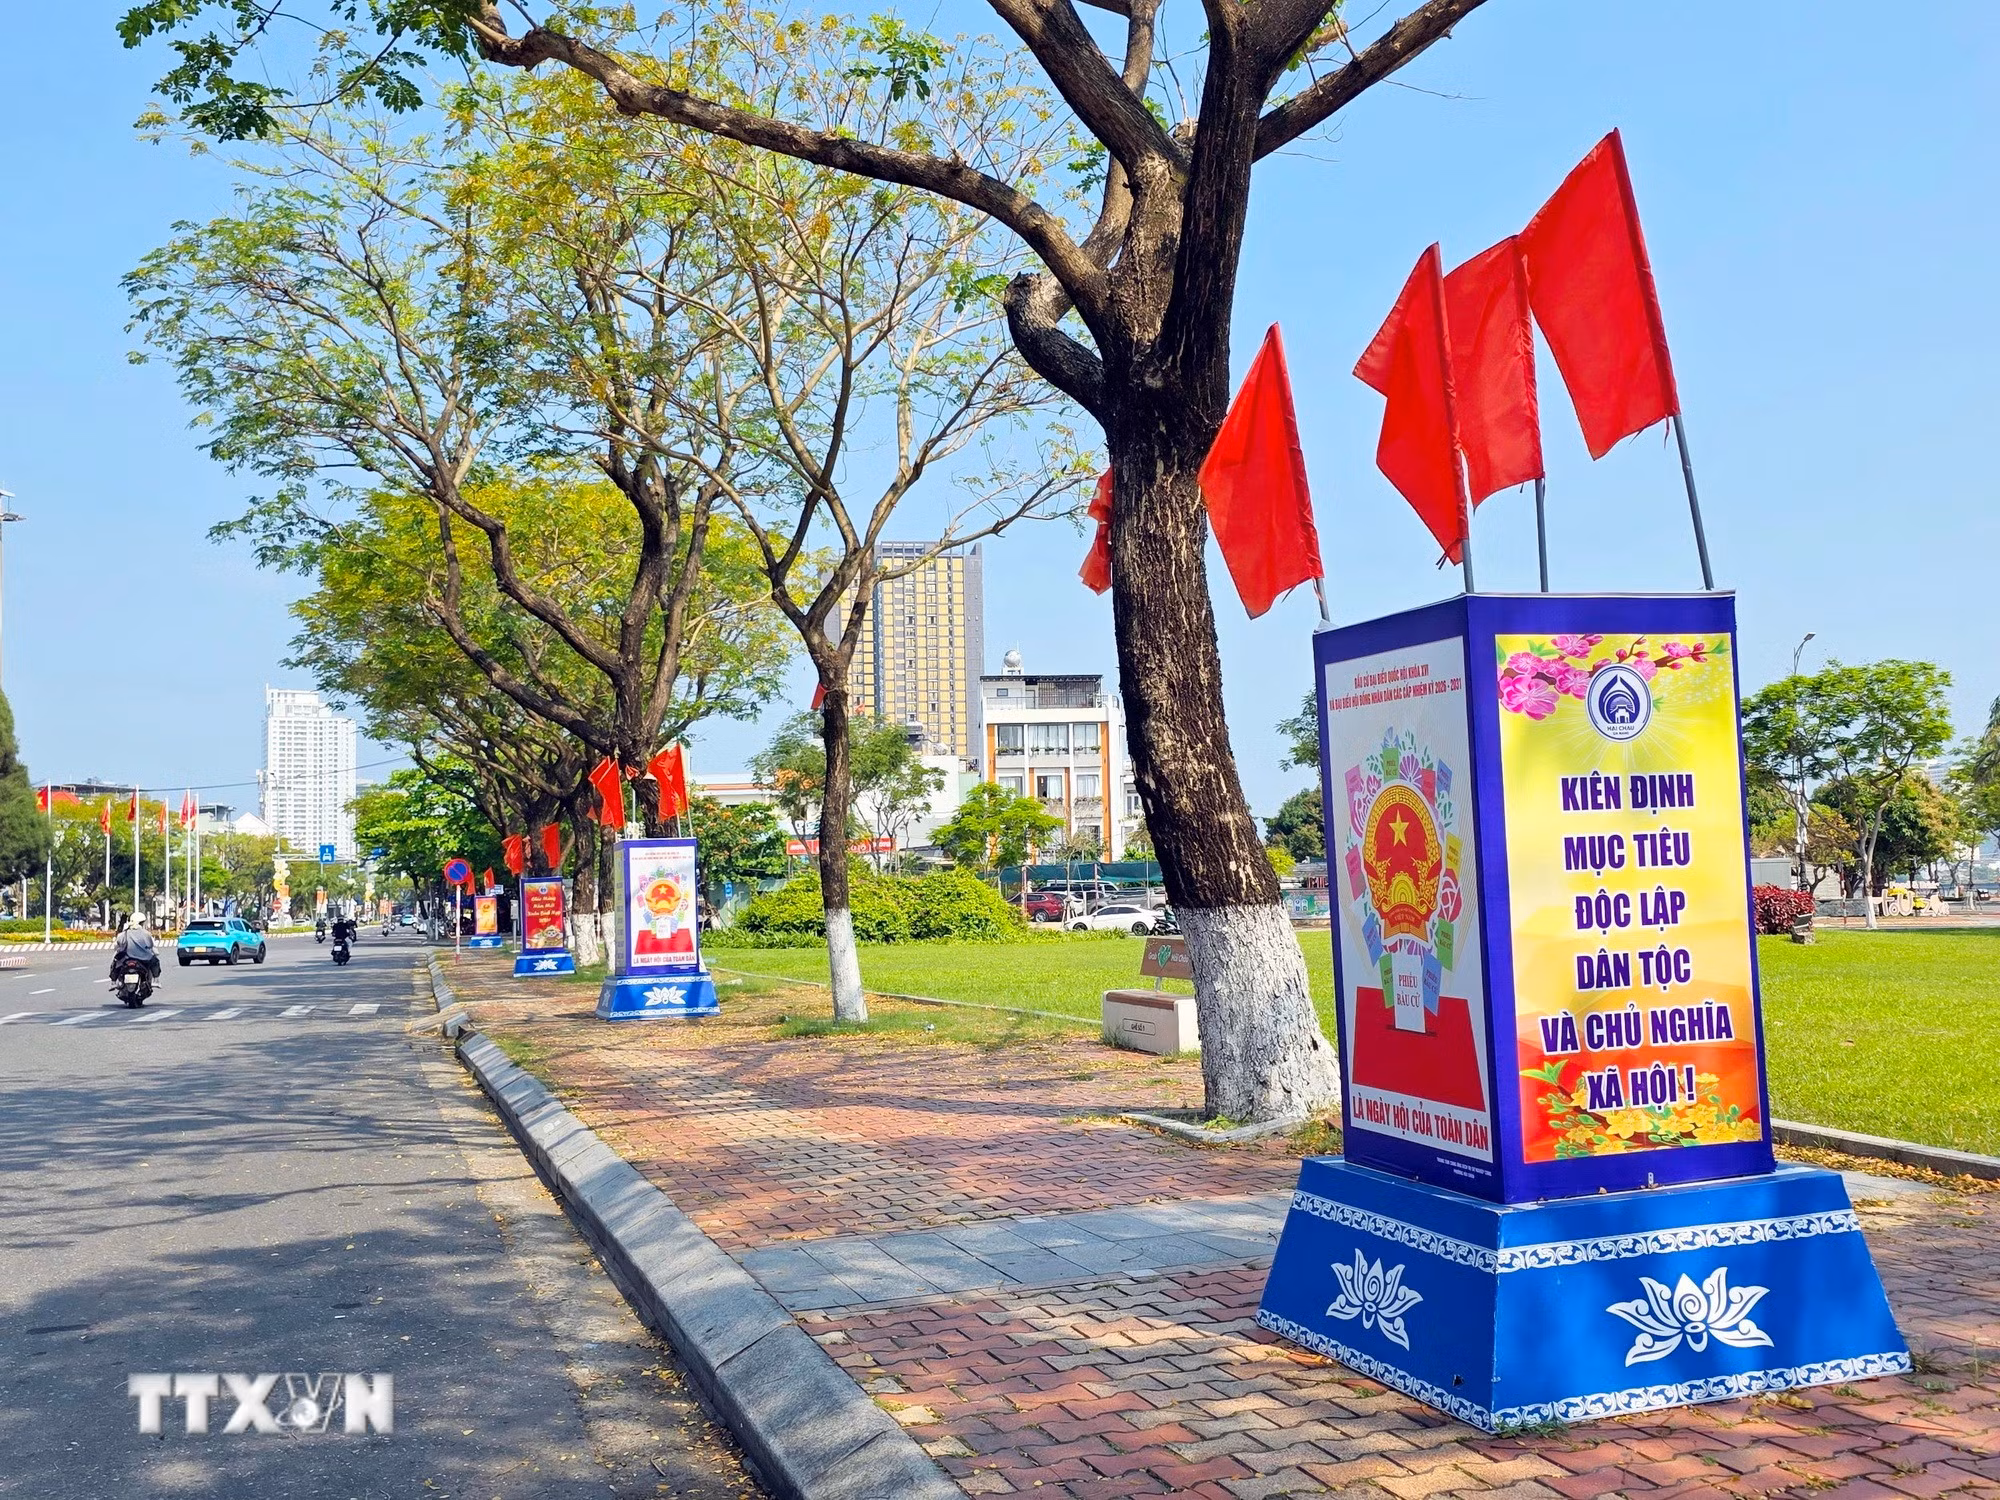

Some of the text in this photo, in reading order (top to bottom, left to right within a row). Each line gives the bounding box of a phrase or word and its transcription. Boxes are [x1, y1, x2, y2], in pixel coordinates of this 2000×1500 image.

[1561, 770, 1694, 814] KIÊN ĐỊNH
[1564, 826, 1691, 876] MỤC TIÊU
[1575, 885, 1686, 935] ĐỘC LẬP
[1576, 944, 1691, 991] DÂN TỘC
[1541, 1001, 1733, 1053] VÀ CHỦ NGHĨA
[1587, 1063, 1694, 1111] XÃ HỘI !
[1352, 1092, 1489, 1151] LÀ NGÀY HỘI CỦA TOÀN DÂN
